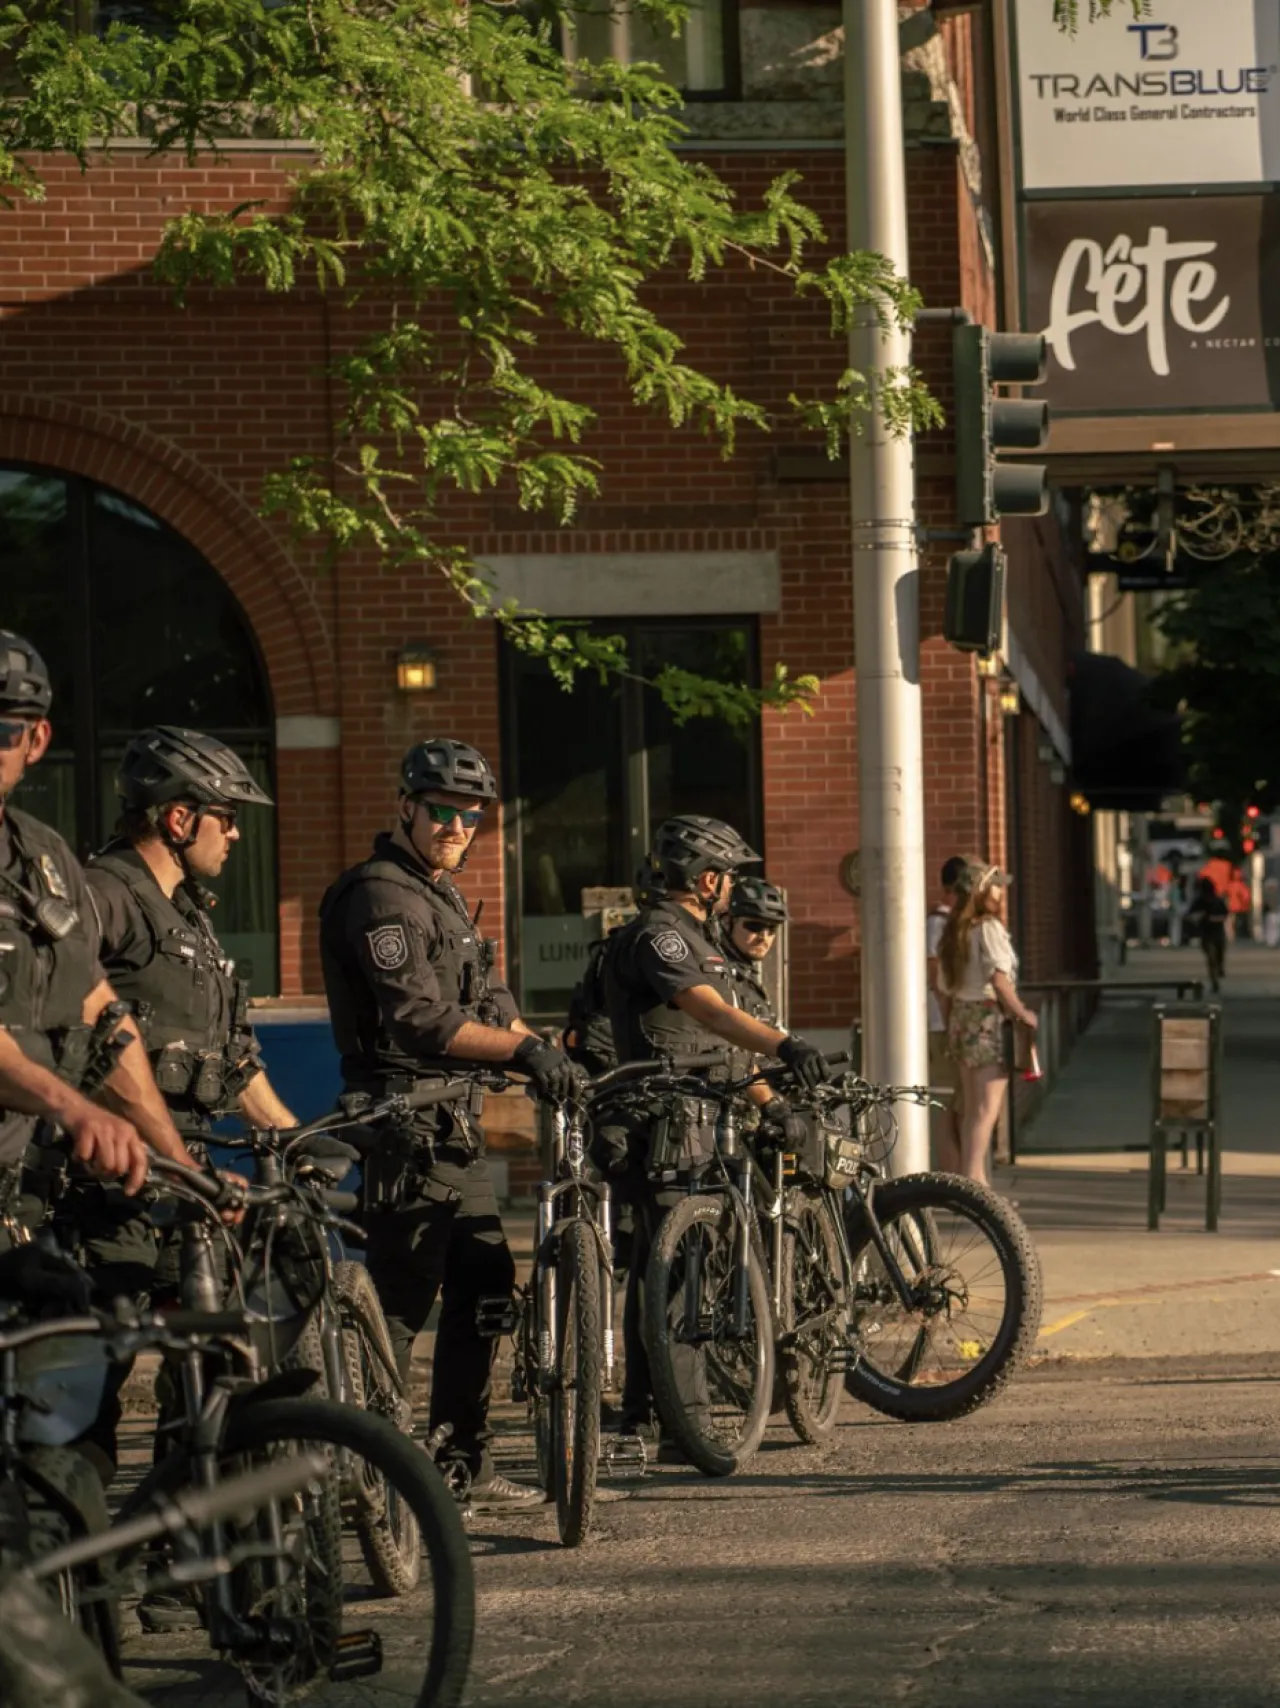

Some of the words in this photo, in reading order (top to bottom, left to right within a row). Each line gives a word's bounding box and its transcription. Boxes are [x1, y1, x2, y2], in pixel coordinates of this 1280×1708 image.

[1029, 67, 1270, 99] TRANSBLUE
[1053, 106, 1091, 123] World
[1093, 106, 1126, 122] Class
[1129, 105, 1178, 121] General
[1180, 103, 1256, 119] Contractors
[1189, 340, 1198, 349] A
[1205, 337, 1256, 349] NECTAR
